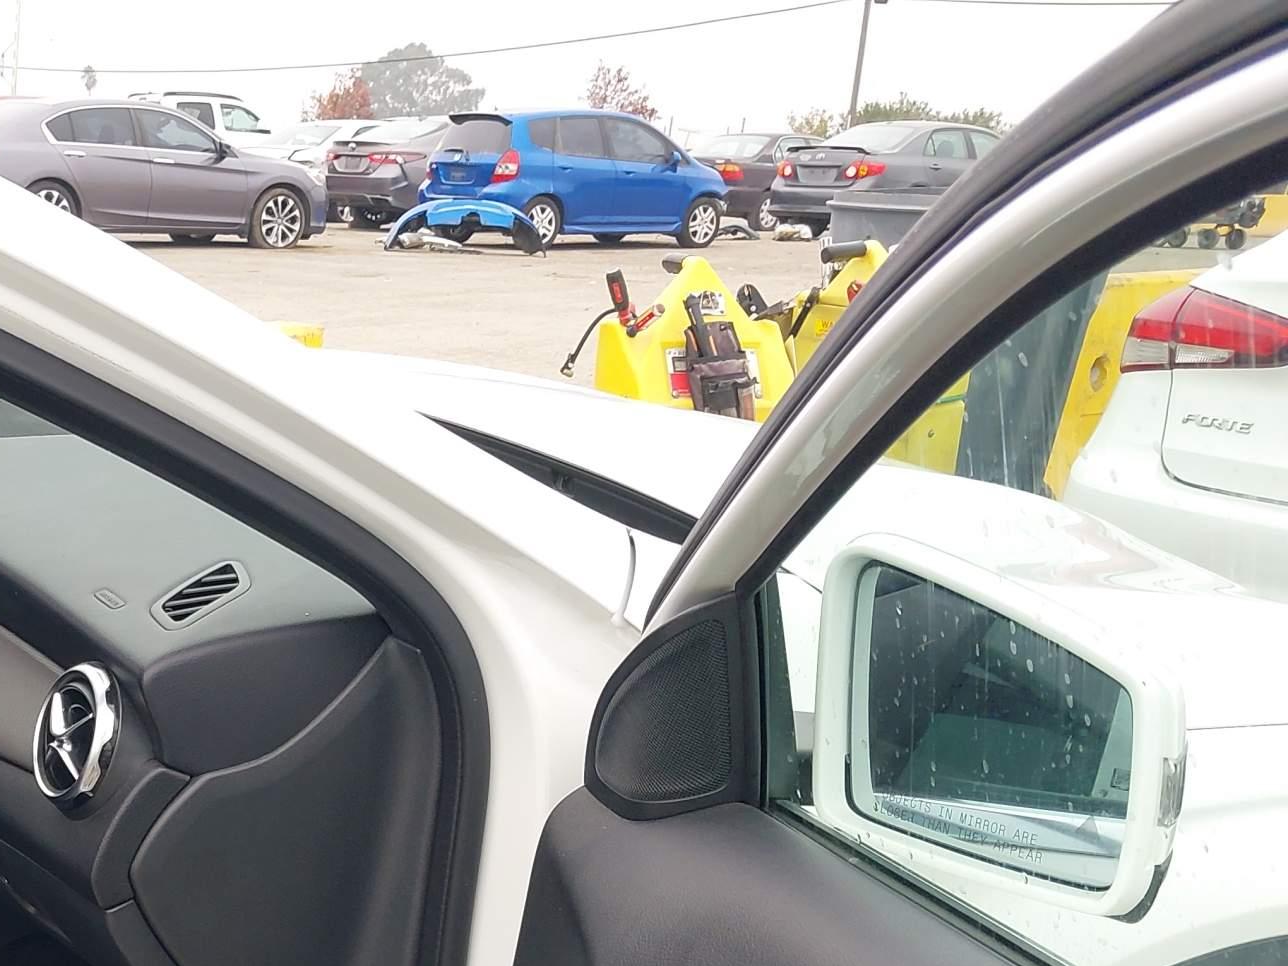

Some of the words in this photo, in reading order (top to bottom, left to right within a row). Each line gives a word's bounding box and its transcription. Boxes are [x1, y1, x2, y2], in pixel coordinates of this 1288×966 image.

[1181, 413, 1255, 435] FORTE
[921, 815, 951, 835] THAN
[957, 825, 989, 846] THEY
[993, 839, 1044, 864] APPEAR
[938, 805, 953, 820] IN
[959, 811, 1007, 837] MIRROR
[1012, 828, 1039, 846] ARE
